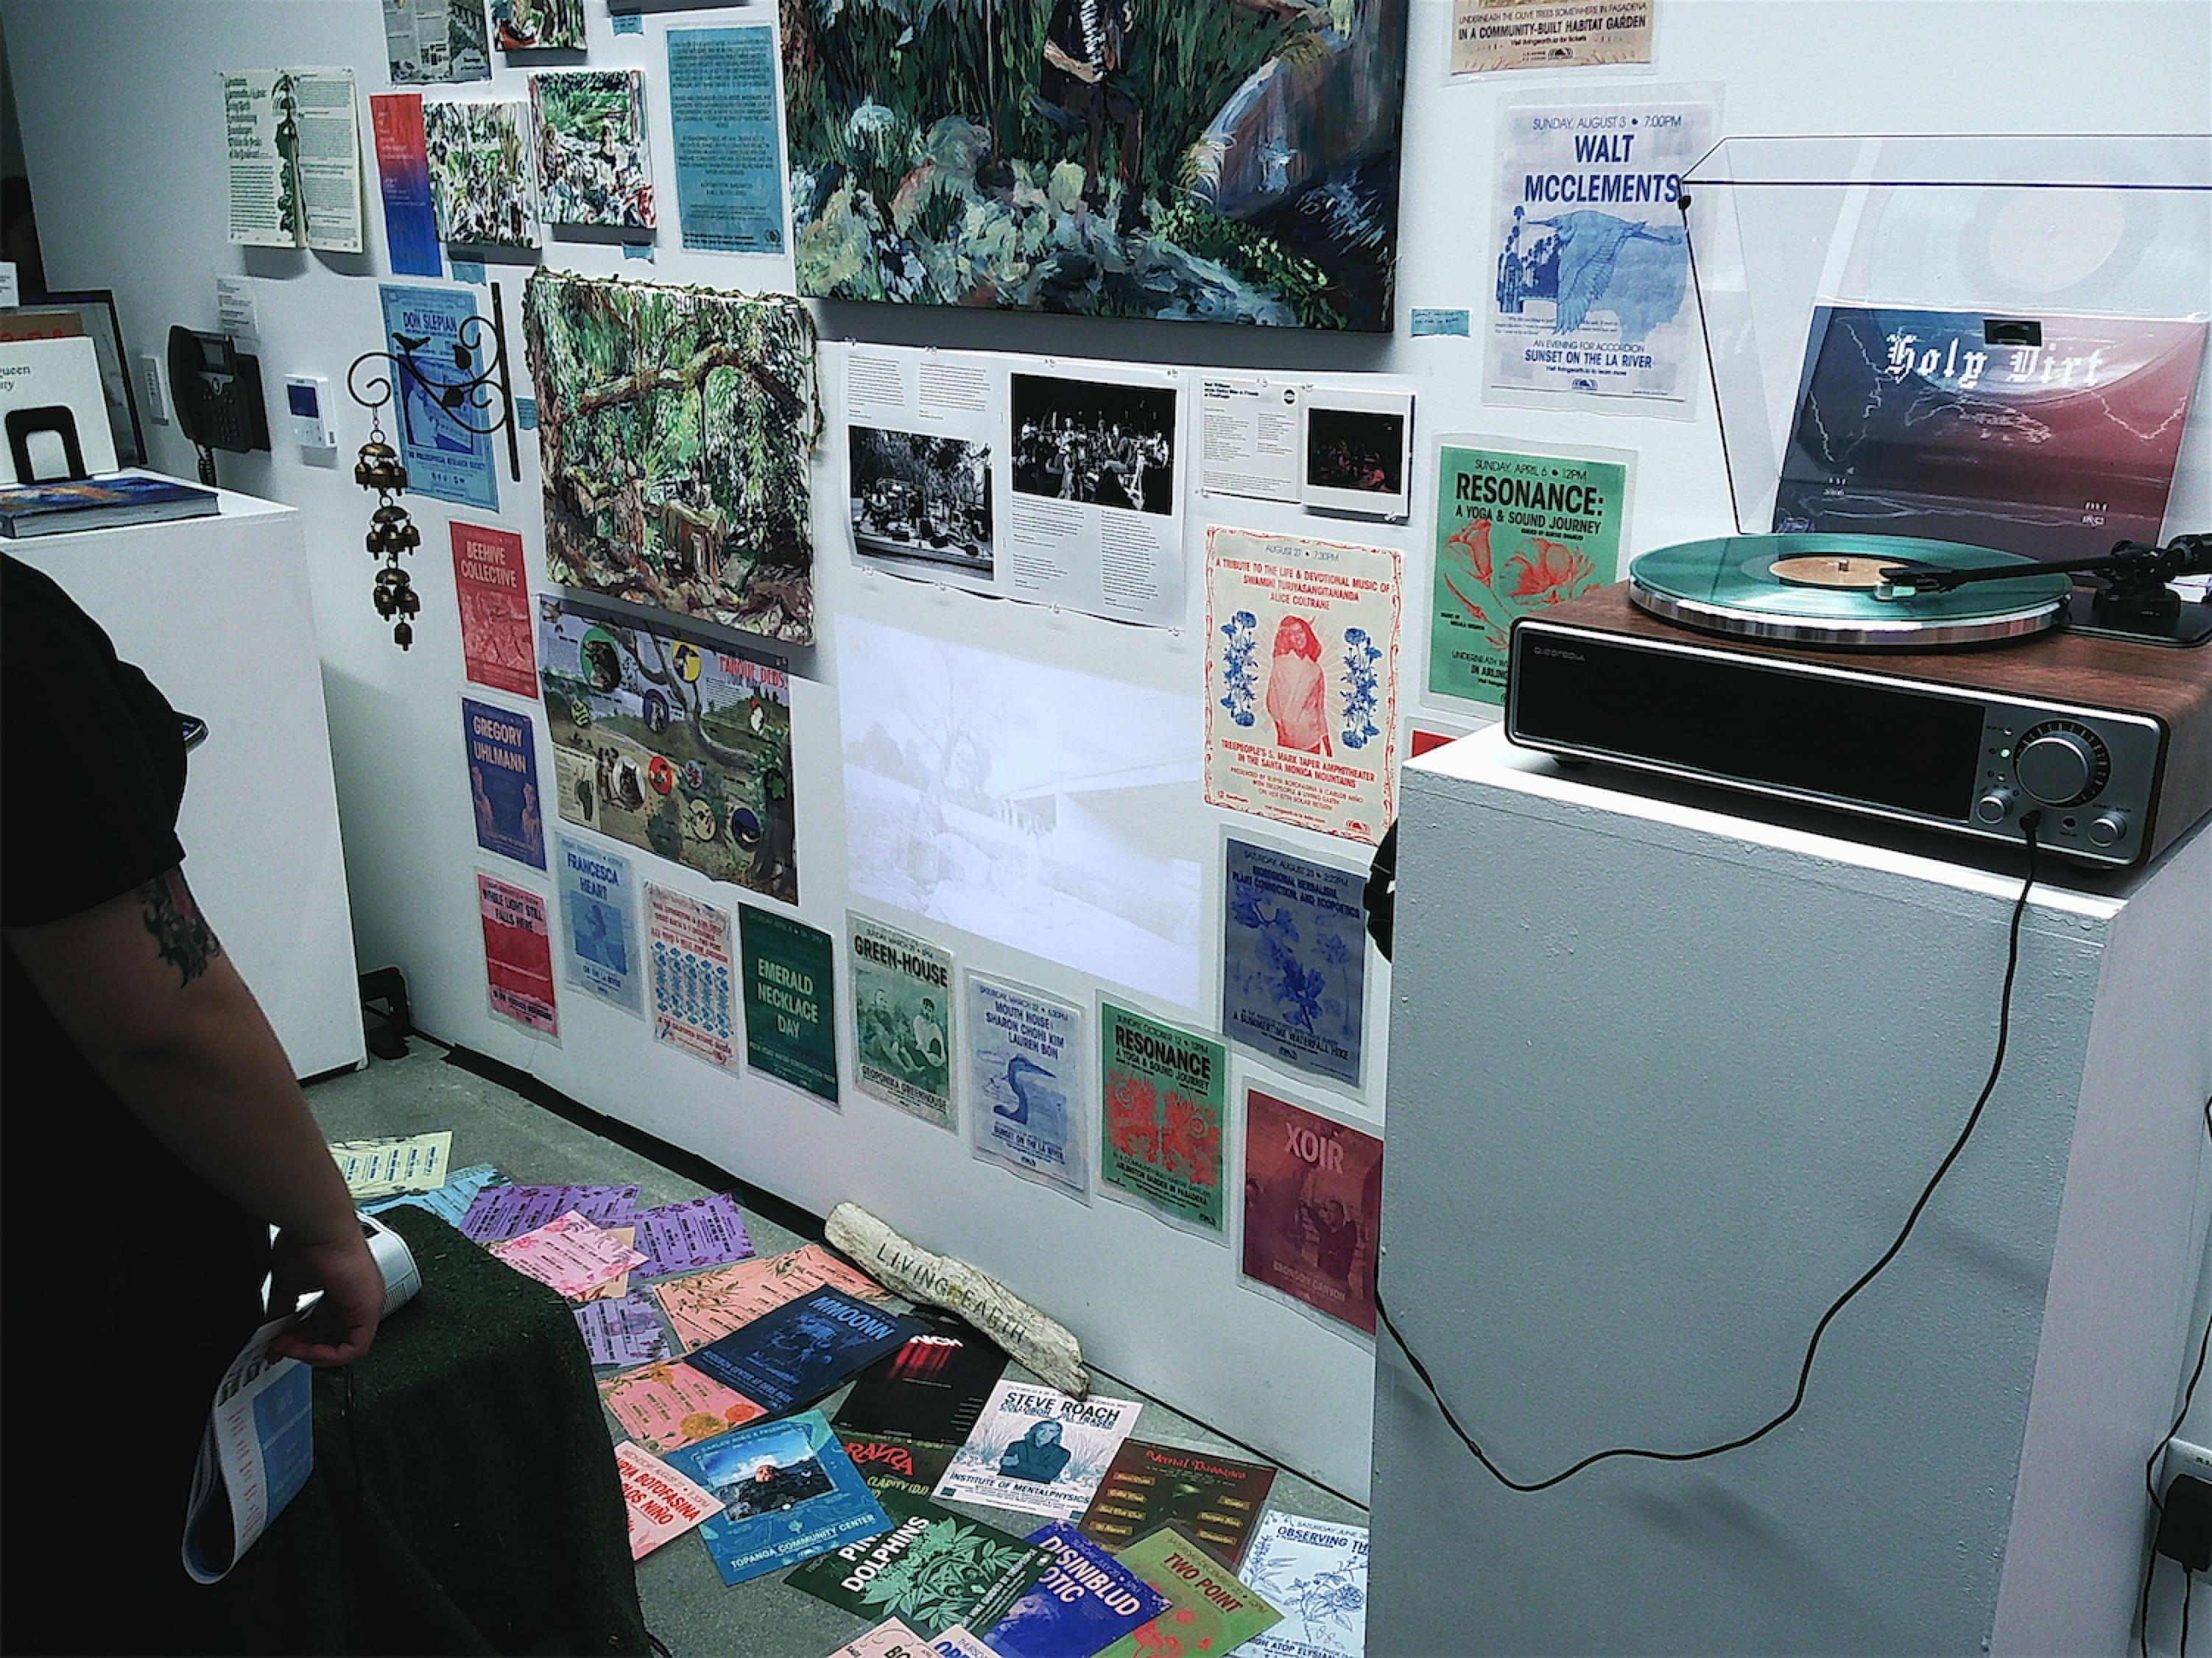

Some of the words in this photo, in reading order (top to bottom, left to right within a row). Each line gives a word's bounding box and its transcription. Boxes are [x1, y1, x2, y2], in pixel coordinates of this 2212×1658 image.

[1459, 28, 1468, 40] IN
[1470, 27, 1476, 39] A
[1479, 21, 1562, 38] COMMUNITY-BUILT
[1565, 18, 1603, 32] HABITAT
[1607, 15, 1646, 30] GARDEN
[1575, 116, 1617, 129] AUGUST
[1619, 116, 1627, 128] 3
[1644, 115, 1682, 127] 7:00PM
[1575, 134, 1634, 163] WALT
[1524, 174, 1680, 202] MCCLEMENTS
[404, 312, 421, 328] DON
[423, 314, 457, 332] SLEPIAN
[1525, 349, 1563, 363] SUNSET
[1566, 351, 1579, 364] ON
[1585, 353, 1602, 364] THE
[1606, 354, 1618, 366] LA
[1622, 355, 1652, 368] RIVER
[1533, 339, 1544, 348] AN
[1546, 340, 1577, 349] EVENING
[1580, 342, 1595, 350] FOR
[1596, 342, 1644, 353] ACCORDION
[1885, 334, 1988, 389] Holy
[2005, 343, 2104, 385] Dirt
[1515, 462, 1539, 475] APRIL
[1456, 472, 1604, 516] RESONANCE:
[1455, 505, 1464, 518] A
[1466, 506, 1493, 521] YOGA
[1496, 510, 1504, 522] &
[1507, 511, 1546, 528] SOUND
[1549, 516, 1602, 535] JOURNEY
[467, 540, 506, 565] BEEHIVE
[461, 560, 517, 588] COLLECTIVE
[1223, 559, 1250, 572] TRIBUTE
[1253, 563, 1262, 572] TO
[1264, 565, 1278, 576] THE
[1280, 567, 1294, 578] LIFE
[1296, 569, 1301, 579] &
[1305, 571, 1349, 587] DEVOTIONAL
[1352, 578, 1378, 591] MUSIC
[1380, 582, 1390, 593] OF
[1269, 591, 1290, 604] ALICE
[1292, 596, 1331, 610] COLTRANE
[473, 716, 523, 747] GREGORY
[473, 741, 526, 774] UHLMANN
[1299, 756, 1320, 769] TAPER
[568, 852, 619, 886] FRANCESCA
[580, 877, 607, 900] HEART
[854, 935, 948, 988] GREEN-HOUSE
[757, 957, 814, 996] EMERALD
[757, 981, 819, 1024] NECKLACE
[777, 1014, 801, 1039] DAY
[986, 1011, 1018, 1031] SHARON
[1049, 1032, 1065, 1049] KIM
[1008, 1031, 1039, 1053] LAUREN
[1040, 1043, 1058, 1060] BON
[1116, 1025, 1211, 1080] RESONANCE
[1123, 1051, 1140, 1065] YOGA
[1284, 1122, 1344, 1174] XOIR
[876, 1243, 948, 1297] LIVING
[959, 1289, 1025, 1344] EARTH
[808, 1296, 896, 1341] MMOONN
[1006, 1392, 1056, 1409] STEVE
[1060, 1402, 1120, 1420] ROACH
[634, 1473, 701, 1521] BOTOFASINA
[949, 1472, 995, 1486] INSTITUTE
[998, 1480, 1011, 1488] OF
[1013, 1484, 1090, 1503] MENTALPHYSICS
[640, 1500, 674, 1525] NIÑO
[730, 1548, 778, 1567] TOPANGA
[778, 1526, 836, 1553] COMMUNITY
[839, 1514, 876, 1532] CENTER
[838, 1533, 881, 1562] PIN
[1278, 1527, 1348, 1547] OBSERVING
[841, 1515, 931, 1592] DOLPHINS
[1039, 1536, 1140, 1615] DISINIBLUD
[1164, 1553, 1200, 1579] TWO
[1194, 1578, 1243, 1613] POINT
[1270, 1642, 1295, 1651] ATOP
